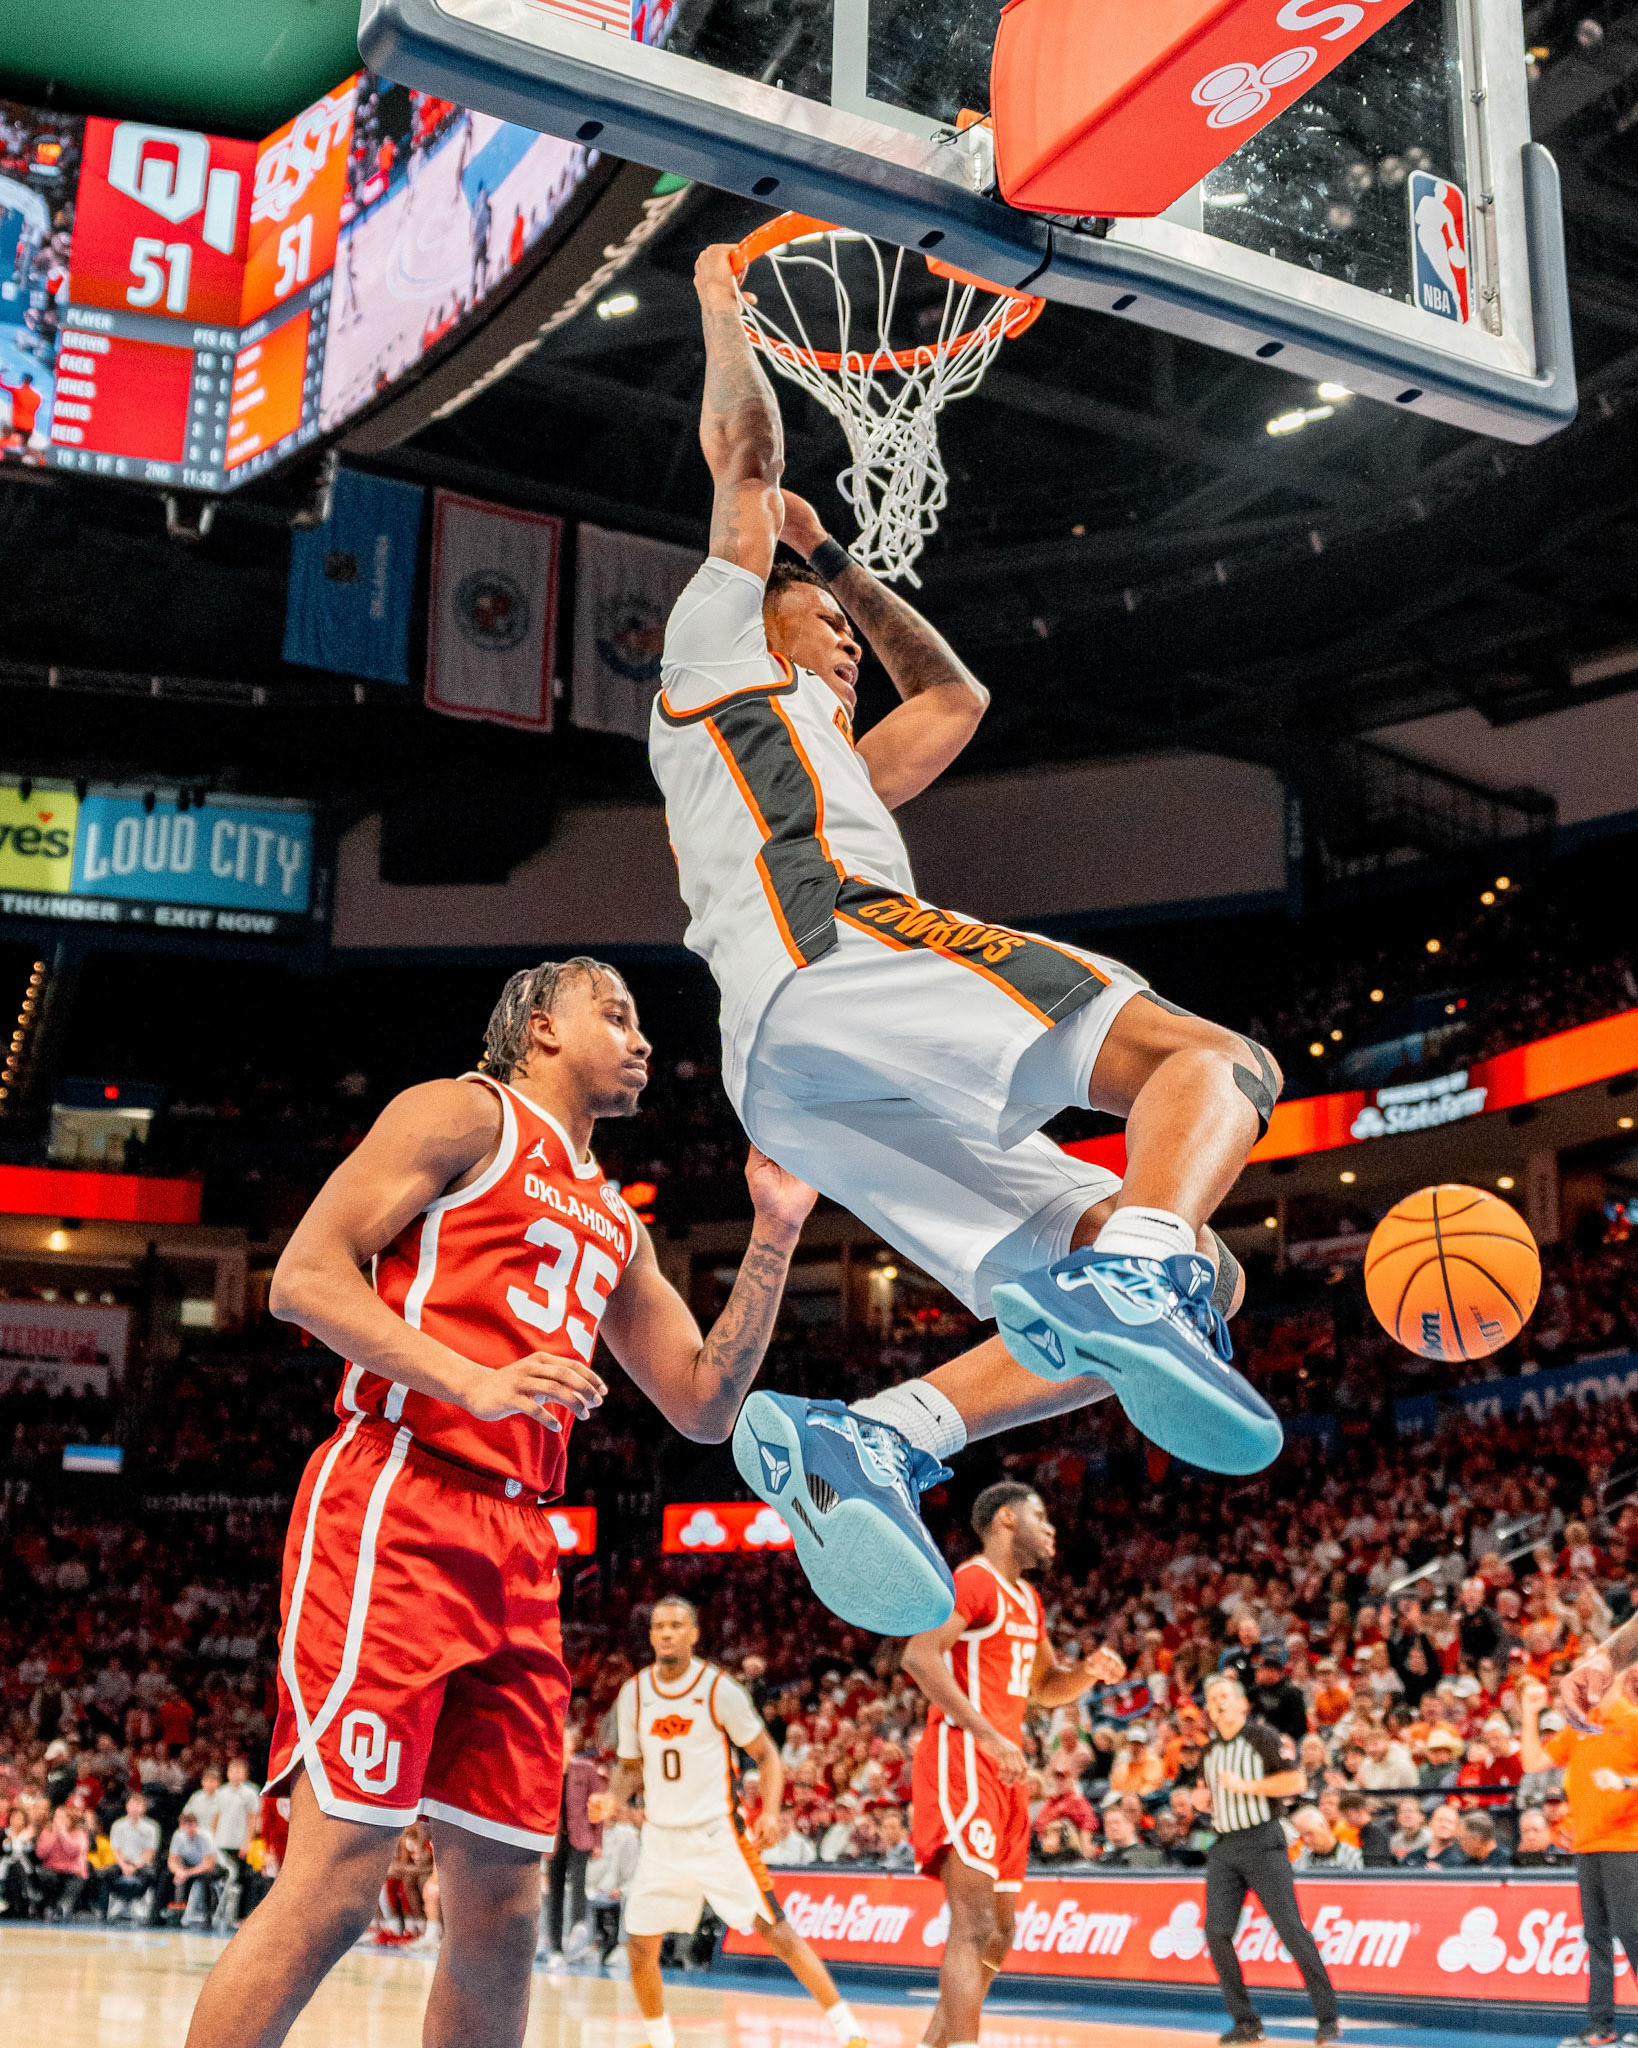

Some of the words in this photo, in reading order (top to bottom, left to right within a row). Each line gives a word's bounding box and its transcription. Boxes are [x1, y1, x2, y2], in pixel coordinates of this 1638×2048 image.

[126, 236, 191, 313] 51
[274, 213, 314, 297] 51
[1423, 283, 1451, 314] NBA
[62, 331, 110, 354] BROWN
[66, 308, 113, 331] PLAYER
[193, 328, 219, 348] PTS
[59, 353, 95, 375] PACK
[56, 377, 96, 399] JONES
[53, 400, 91, 422] DAVIS
[51, 423, 83, 444] REID
[145, 462, 174, 482] 2ND
[83, 815, 196, 882] LOUD
[210, 818, 303, 896] CITY
[3, 894, 119, 922] THUNDER
[154, 906, 211, 929] EXIT
[216, 911, 276, 934] NOW
[858, 898, 1026, 963] COWBOYS
[524, 1173, 625, 1261] OKLAHOMA
[506, 1217, 618, 1363] 35
[1007, 1641, 1036, 1698] 12
[339, 1709, 401, 1795] OU
[663, 1748, 681, 1780] 0
[969, 1818, 996, 1860] OU
